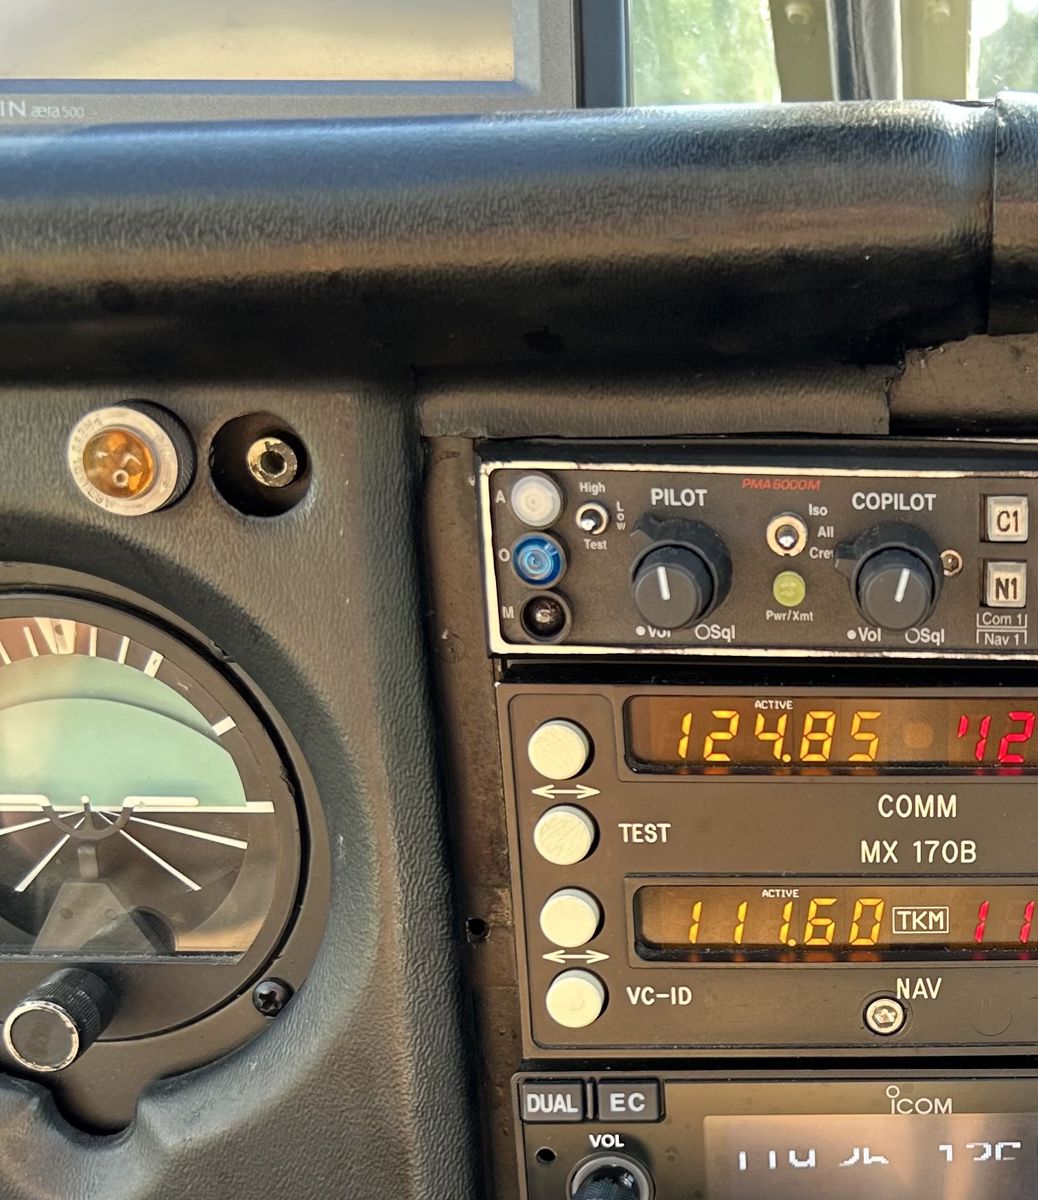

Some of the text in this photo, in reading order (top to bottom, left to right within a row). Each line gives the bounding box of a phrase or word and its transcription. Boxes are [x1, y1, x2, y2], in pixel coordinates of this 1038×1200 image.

[579, 481, 606, 495] High
[650, 488, 708, 508] PILOT
[808, 504, 829, 517] Iso
[851, 493, 937, 512] COPILOT
[817, 525, 834, 539] All
[583, 538, 608, 551] Test
[765, 609, 814, 624] Pwr/Xmt
[754, 699, 793, 711] ACTIVE
[677, 710, 882, 763] 124.85
[877, 793, 957, 818] COMM
[618, 822, 672, 844] TEST
[859, 840, 978, 865] MX 170B
[761, 888, 800, 899] ACTIVE
[687, 898, 886, 947] 111.60
[896, 910, 946, 930] TKM
[625, 986, 692, 1006] VC-ID
[895, 977, 943, 1000] NAV
[526, 1093, 578, 1113] DUAL
[589, 1134, 625, 1149] VOL
